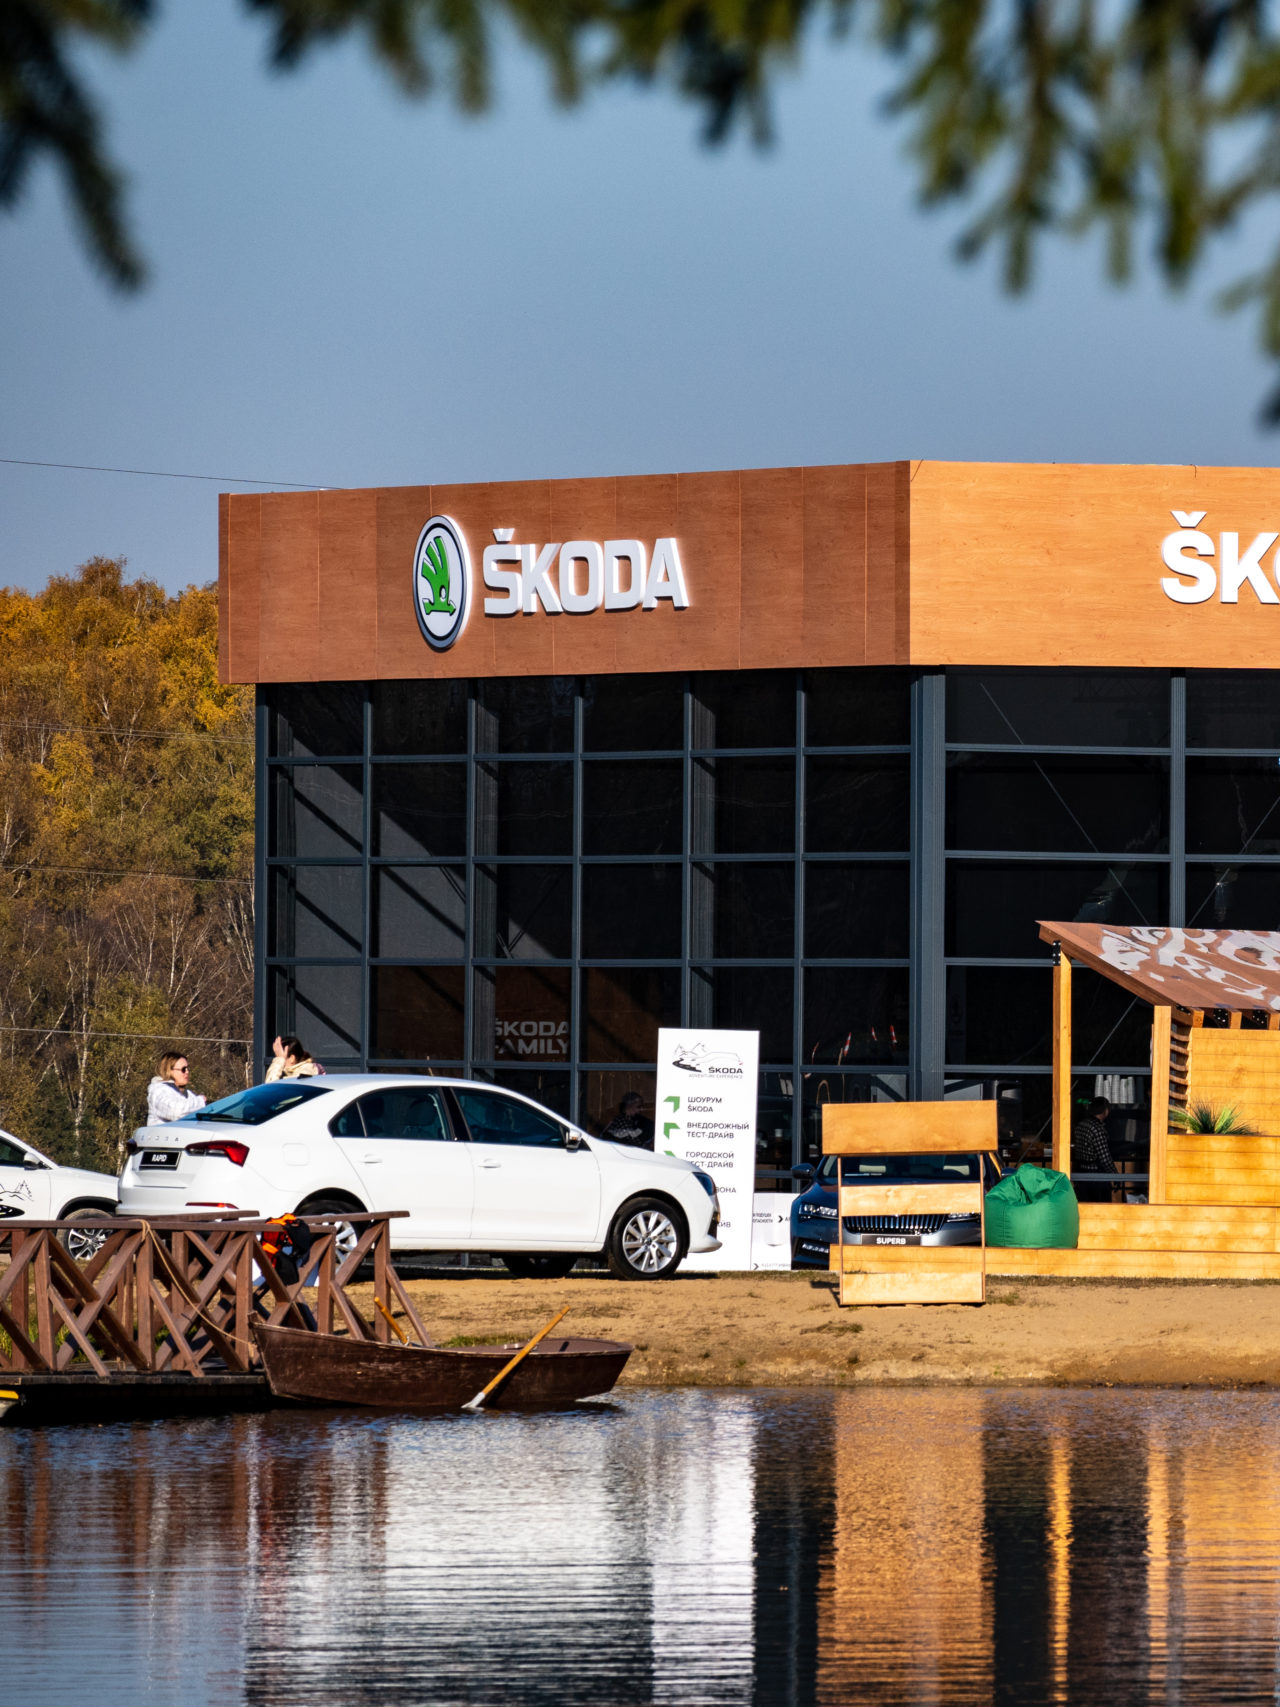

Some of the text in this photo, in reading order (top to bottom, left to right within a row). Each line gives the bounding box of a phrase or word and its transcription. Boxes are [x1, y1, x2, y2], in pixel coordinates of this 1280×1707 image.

[482, 527, 690, 617] ŠKODA
[687, 1096, 722, 1104] ШОУРУМ
[687, 1121, 750, 1130] ВНЕДОРОЖНЫЙ
[687, 1131, 734, 1139] ТЕСТ-ДРАЙВ
[689, 1160, 734, 1168] ЕСТ-ДРАЙВ
[875, 1237, 907, 1245] SUPERB
